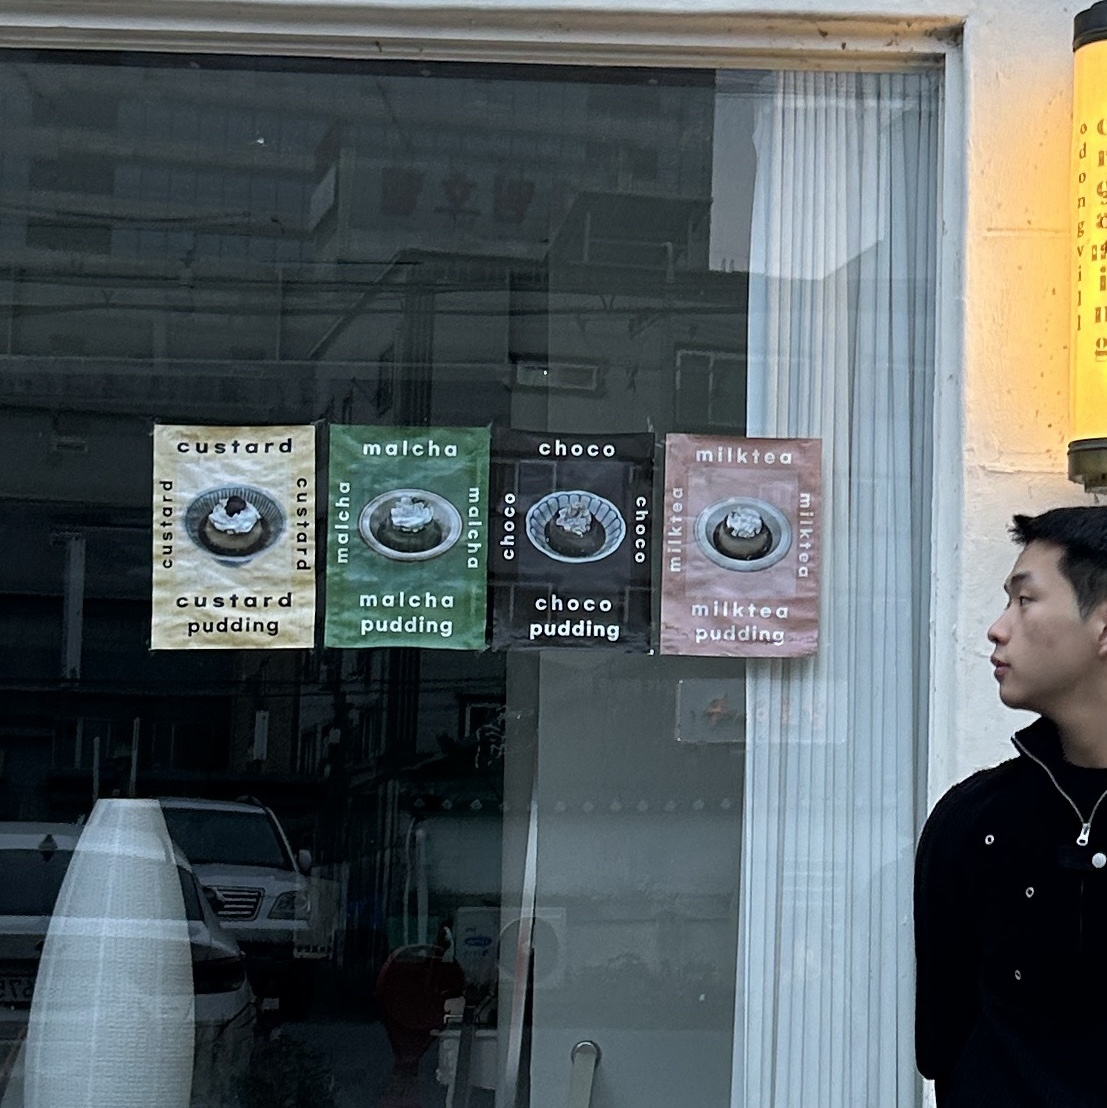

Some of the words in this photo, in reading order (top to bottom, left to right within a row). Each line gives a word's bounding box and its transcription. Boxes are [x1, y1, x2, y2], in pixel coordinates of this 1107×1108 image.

[1076, 121, 1088, 331] odongvill
[177, 437, 292, 454] custard
[538, 439, 616, 457] choco
[696, 446, 792, 465] milktea
[159, 480, 173, 569] custard
[296, 477, 312, 571] custard
[499, 493, 516, 560] choco
[634, 496, 649, 563] choco
[667, 487, 683, 572] milktea
[798, 492, 814, 578] milktea
[176, 591, 293, 609] custard
[535, 594, 612, 612] choco
[691, 600, 788, 619] milktea
[187, 616, 279, 637] pudding
[361, 615, 453, 637] pudding
[529, 619, 620, 642] pudding
[695, 625, 785, 646] pudding
